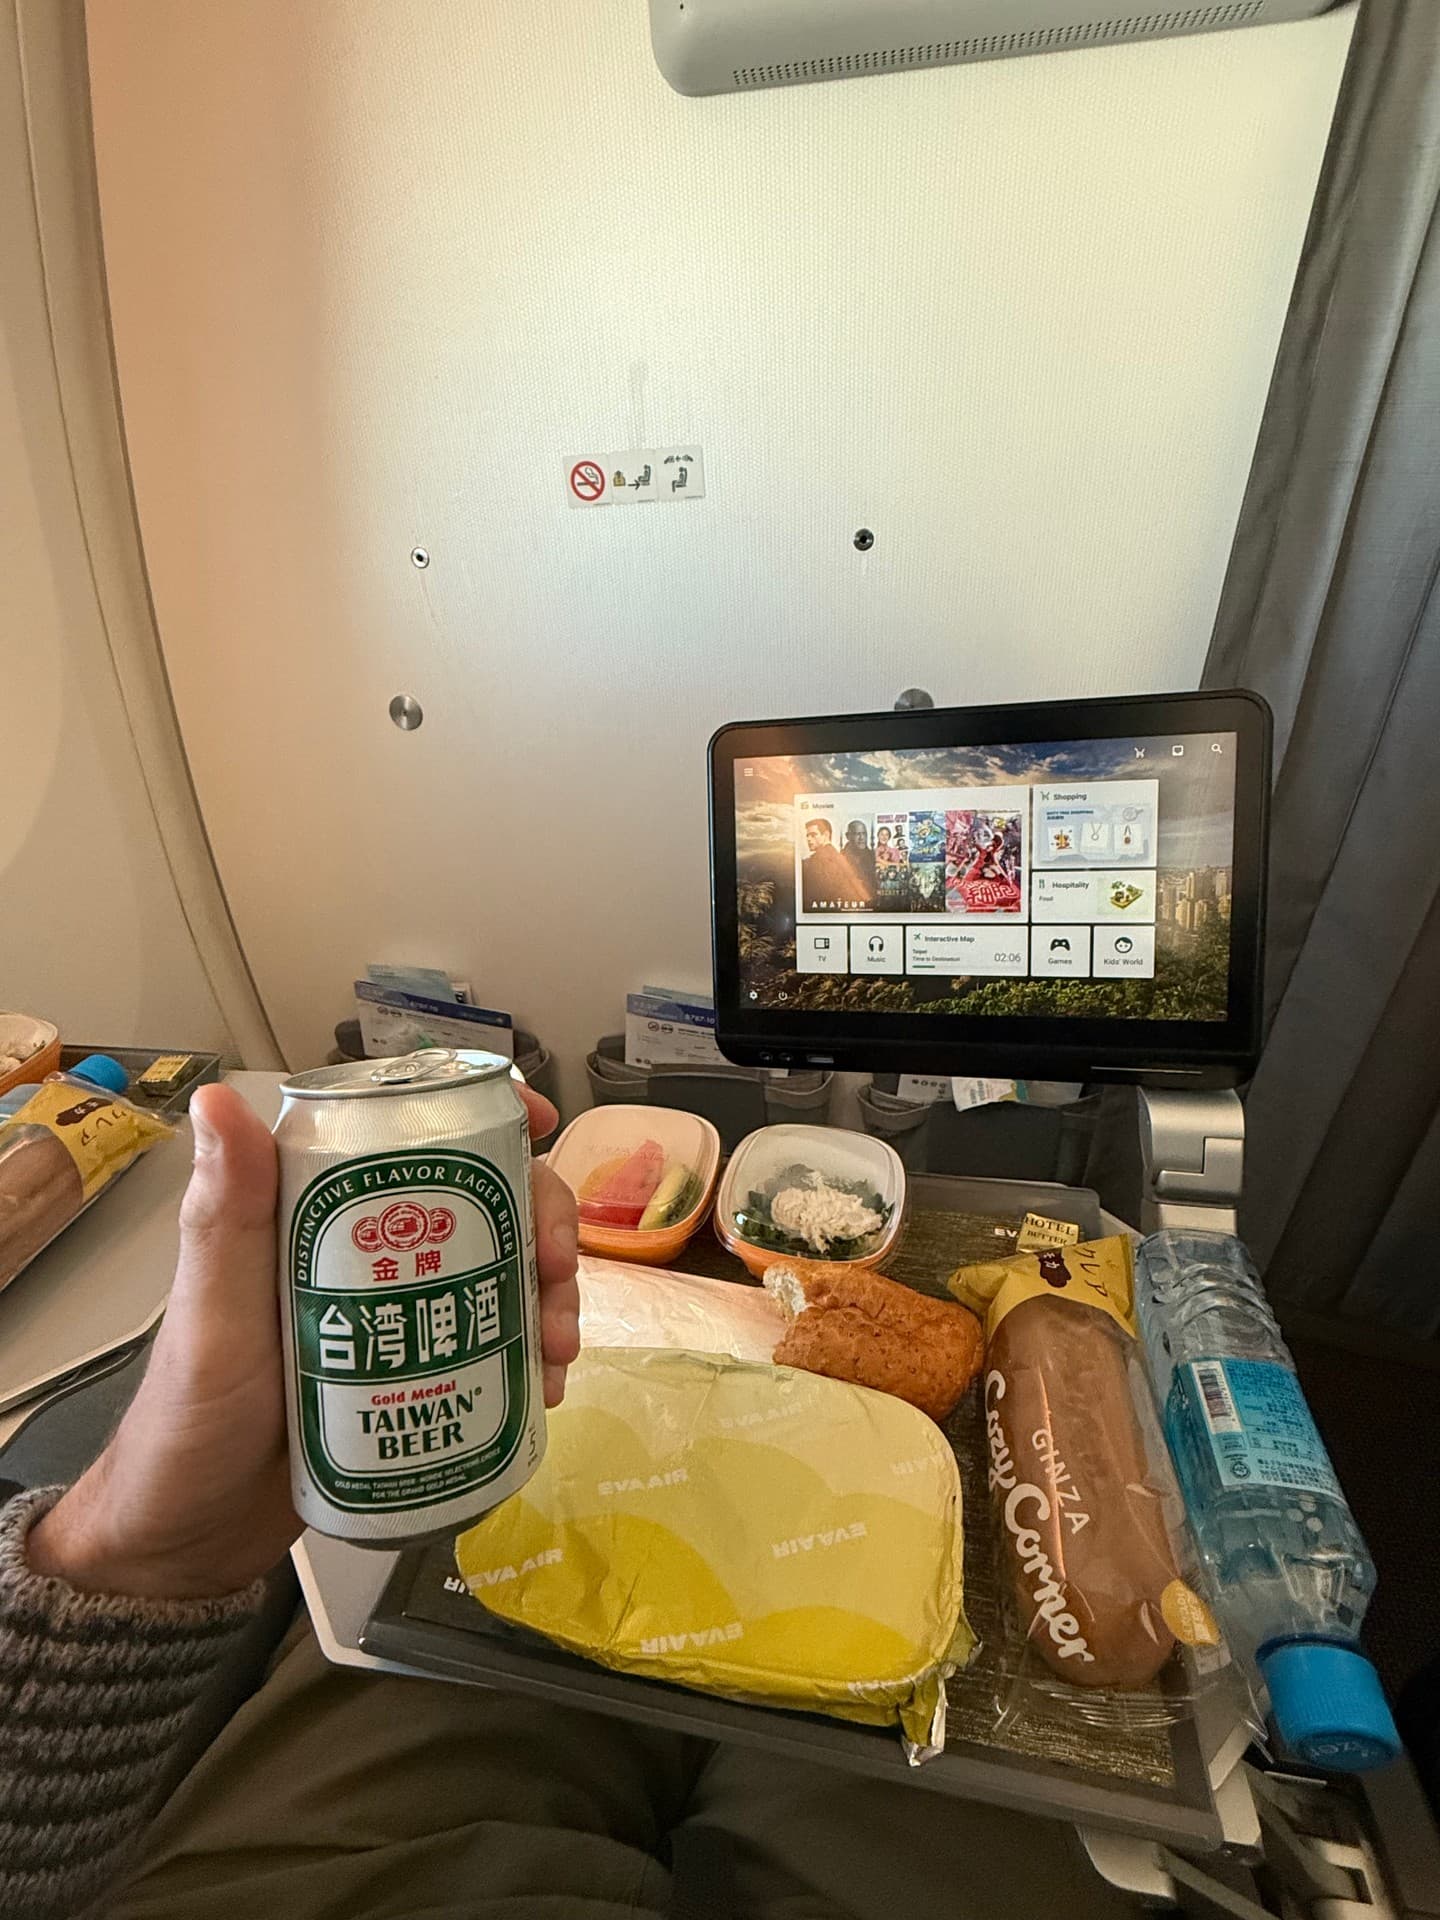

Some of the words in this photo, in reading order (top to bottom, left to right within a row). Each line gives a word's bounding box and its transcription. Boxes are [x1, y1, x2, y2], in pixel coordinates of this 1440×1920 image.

[1053, 792, 1087, 801] Shopping
[1052, 881, 1089, 889] Hospitality
[811, 901, 866, 909] AMATEUR
[960, 935, 975, 944] Map
[867, 955, 886, 963] Music
[994, 953, 1021, 963] 02:06
[1048, 957, 1072, 965] Games
[1122, 957, 1143, 966] World
[297, 1179, 354, 1282] DISTINCTIVE
[363, 1165, 445, 1188] FLAVOR
[454, 1168, 501, 1207] LAGER
[498, 1209, 513, 1254] BEER
[1025, 1216, 1074, 1237] HOTEL
[994, 1227, 1020, 1238] EV
[371, 1249, 442, 1283] 金牌
[371, 1391, 405, 1406] Gold
[411, 1380, 457, 1400] Medal
[356, 1389, 475, 1434] TAIWAN
[377, 1422, 464, 1461] BEER
[334, 1480, 350, 1490] GOLD
[351, 1481, 371, 1490] MEDAL
[373, 1481, 398, 1490] TAIWAN
[1031, 1428, 1091, 1535] GINZA
[372, 1491, 385, 1499] FOR
[387, 1489, 400, 1498] THE
[426, 1480, 444, 1491] GOLD
[984, 1369, 1017, 1492] Cozy
[1004, 1483, 1096, 1662] Corner
[443, 1576, 474, 1596] IR
